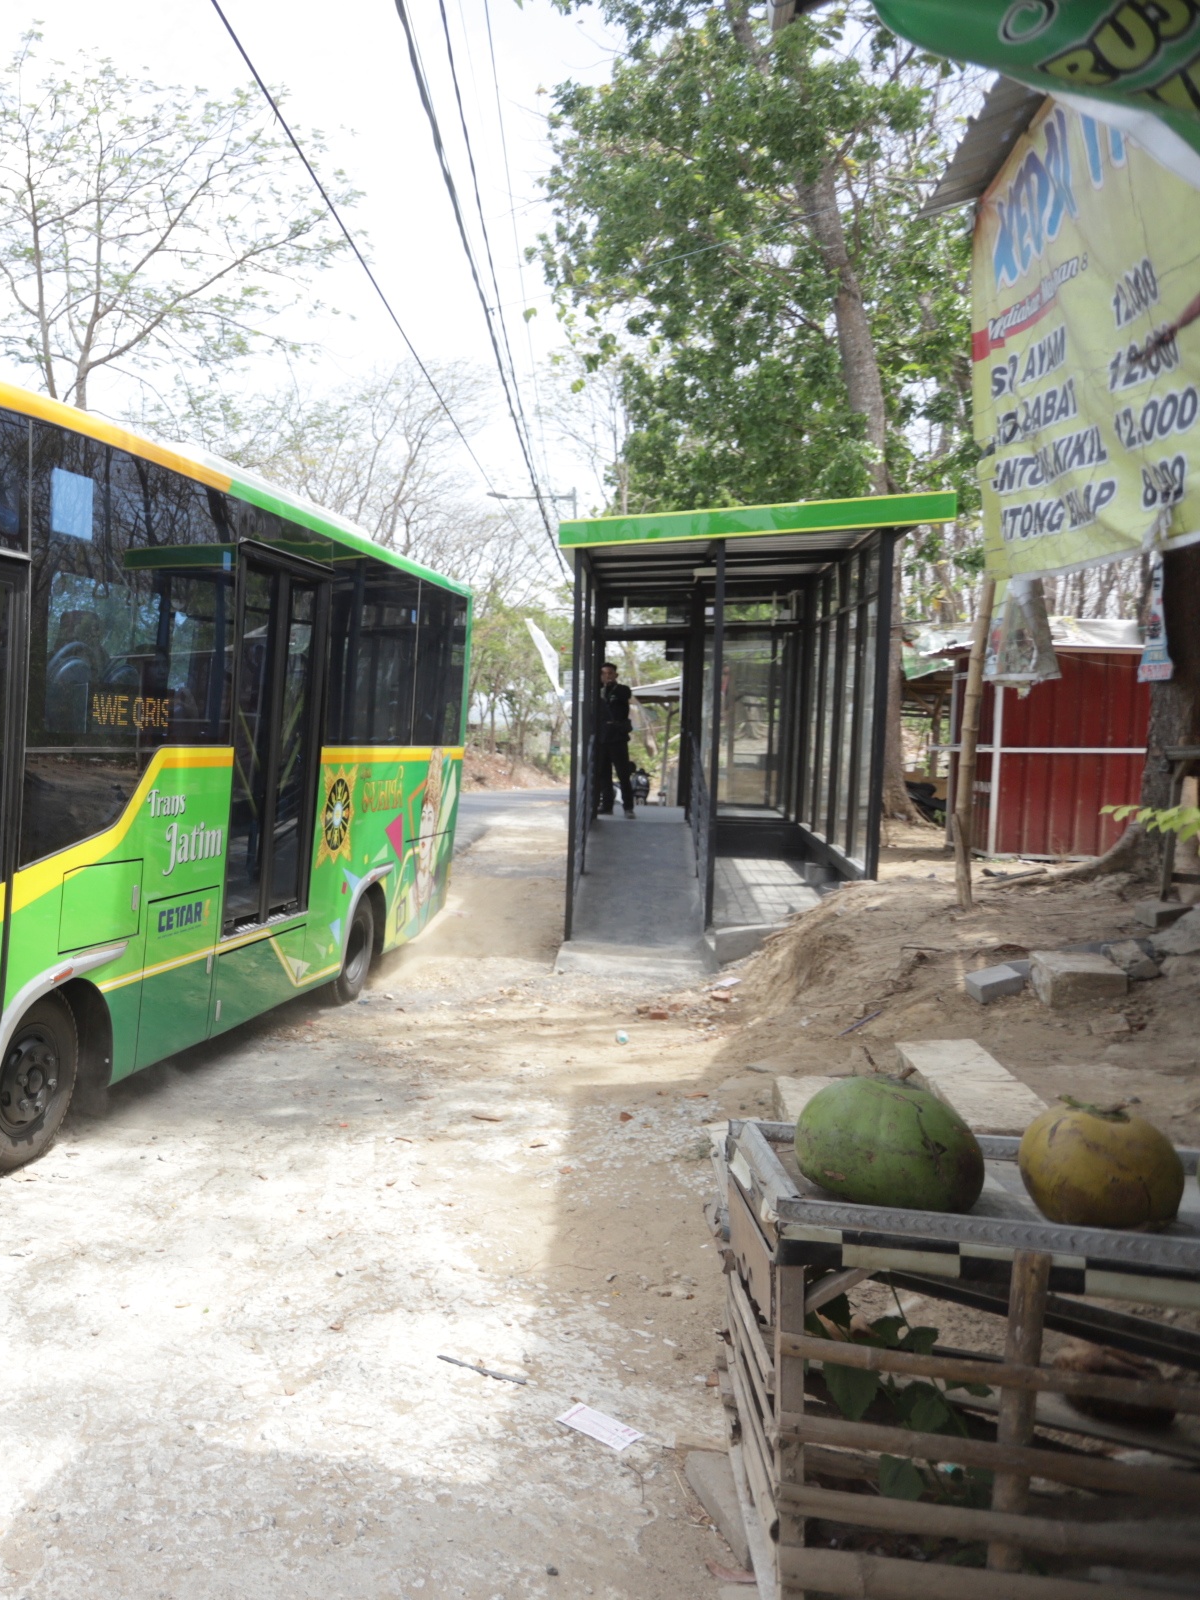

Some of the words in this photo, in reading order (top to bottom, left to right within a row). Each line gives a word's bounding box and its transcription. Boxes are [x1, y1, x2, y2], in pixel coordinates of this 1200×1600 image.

[1021, 326, 1065, 383] AYAM
[1115, 386, 1198, 448] 12.000
[132, 697, 170, 731] QRIS
[147, 789, 186, 818] Trans
[162, 821, 222, 877] Jatim
